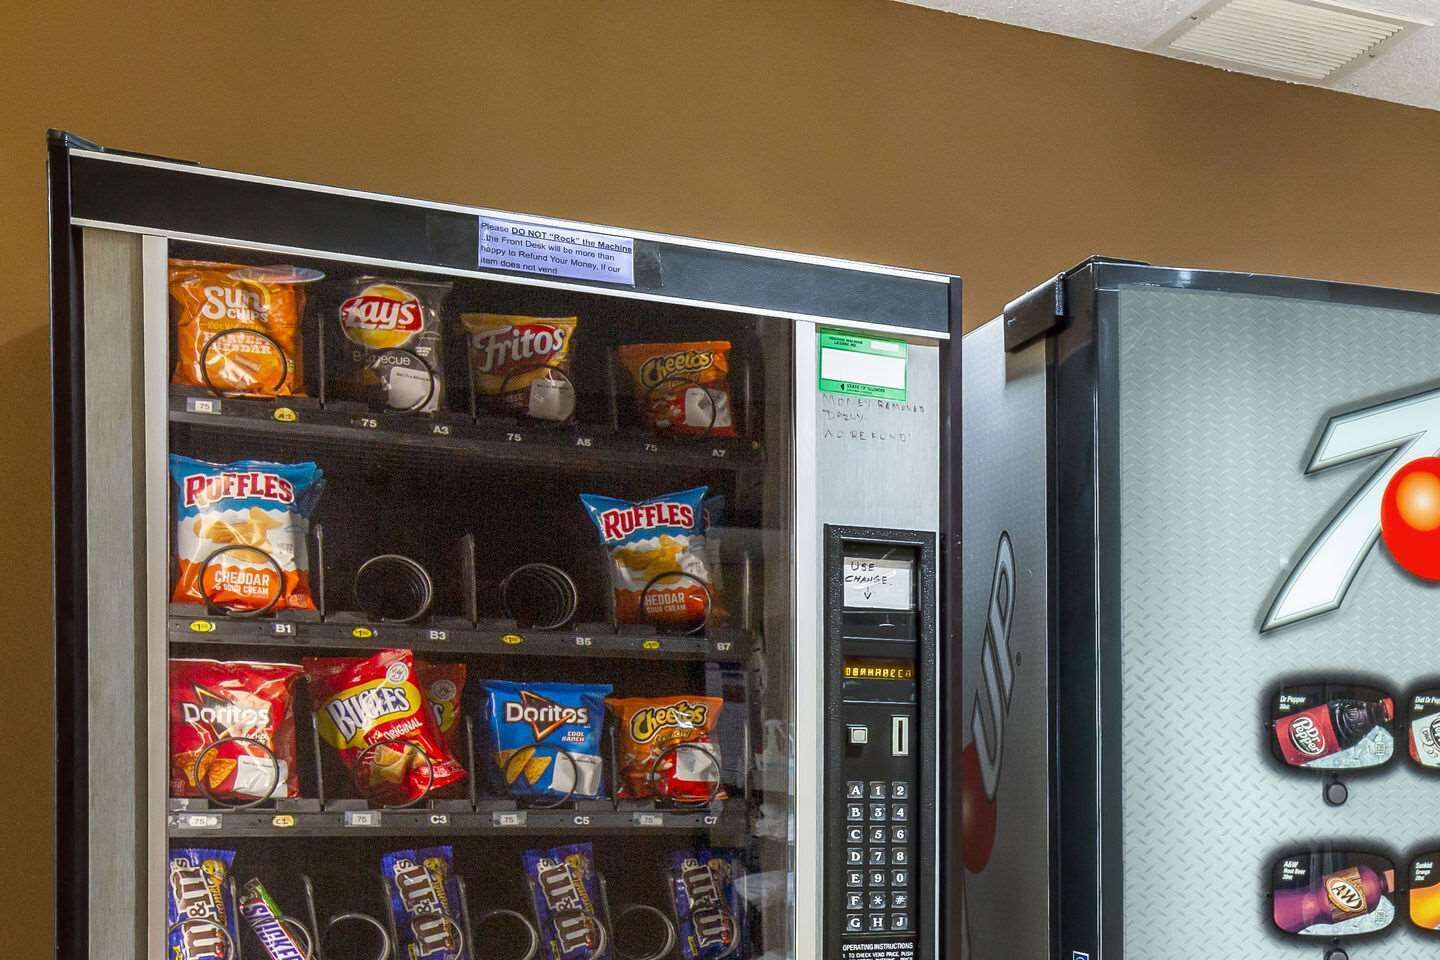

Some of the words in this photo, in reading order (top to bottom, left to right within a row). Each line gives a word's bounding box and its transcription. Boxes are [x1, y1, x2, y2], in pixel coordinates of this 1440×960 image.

[481, 222, 509, 233] Please
[511, 227, 525, 236] DO
[528, 230, 547, 240] NOT
[582, 238, 596, 248] the
[597, 241, 632, 254] Machine
[502, 236, 523, 247] Front
[525, 240, 546, 251] Desk
[548, 243, 561, 253] will
[563, 245, 573, 255] be
[575, 249, 596, 258] more
[597, 250, 615, 261] than
[481, 245, 506, 257] happy
[508, 247, 516, 257] to
[518, 251, 548, 262] Refund
[550, 255, 568, 265] Your
[607, 265, 621, 273] our
[481, 256, 498, 266] item
[500, 259, 521, 269] does
[522, 262, 536, 272] not
[203, 285, 271, 320] Sun
[227, 308, 269, 323] CHIPS
[343, 298, 416, 330] Lay's
[473, 325, 567, 372] Fritos
[640, 351, 714, 389] Cheetos
[360, 418, 378, 429] 75
[432, 424, 449, 435] A3
[506, 433, 522, 442] 75
[711, 448, 726, 458] A7
[184, 472, 295, 507] RUFFLES
[602, 502, 694, 540] RUFFLES
[850, 561, 876, 572] USE
[214, 570, 270, 586] CHEDDAR
[844, 575, 888, 586] CHANGE
[243, 585, 270, 597] CREAM
[275, 624, 292, 634] B1
[430, 630, 447, 641] B3
[1280, 695, 1287, 703] Dr
[1287, 696, 1307, 704] Pepper
[182, 702, 271, 726] Doritos
[329, 686, 411, 743] BUGLES
[505, 701, 590, 725] Doritos
[629, 701, 708, 744] Cheetos
[382, 716, 424, 741] ORIGINAL
[567, 730, 586, 738] COOL
[851, 785, 861, 796] A
[875, 786, 882, 796] 1
[896, 785, 905, 796] 2
[851, 807, 861, 817] B
[874, 807, 883, 817] 3
[896, 807, 905, 817] 4
[430, 815, 448, 825] C3
[574, 816, 591, 826] C5
[704, 816, 719, 826] C7
[850, 829, 861, 840] C
[874, 830, 882, 839] 5
[896, 830, 905, 839] 6
[851, 852, 861, 862] D
[874, 851, 882, 861] 7
[896, 851, 904, 861] 8
[1415, 861, 1433, 869] Sunkist
[851, 873, 861, 884] E
[874, 873, 882, 883] 9
[896, 873, 904, 883] 0
[851, 895, 861, 906] F
[895, 895, 907, 905] #
[850, 918, 861, 928] G
[872, 917, 883, 927] H
[896, 917, 904, 927] J
[874, 942, 914, 950] INSTRUCTIONS
